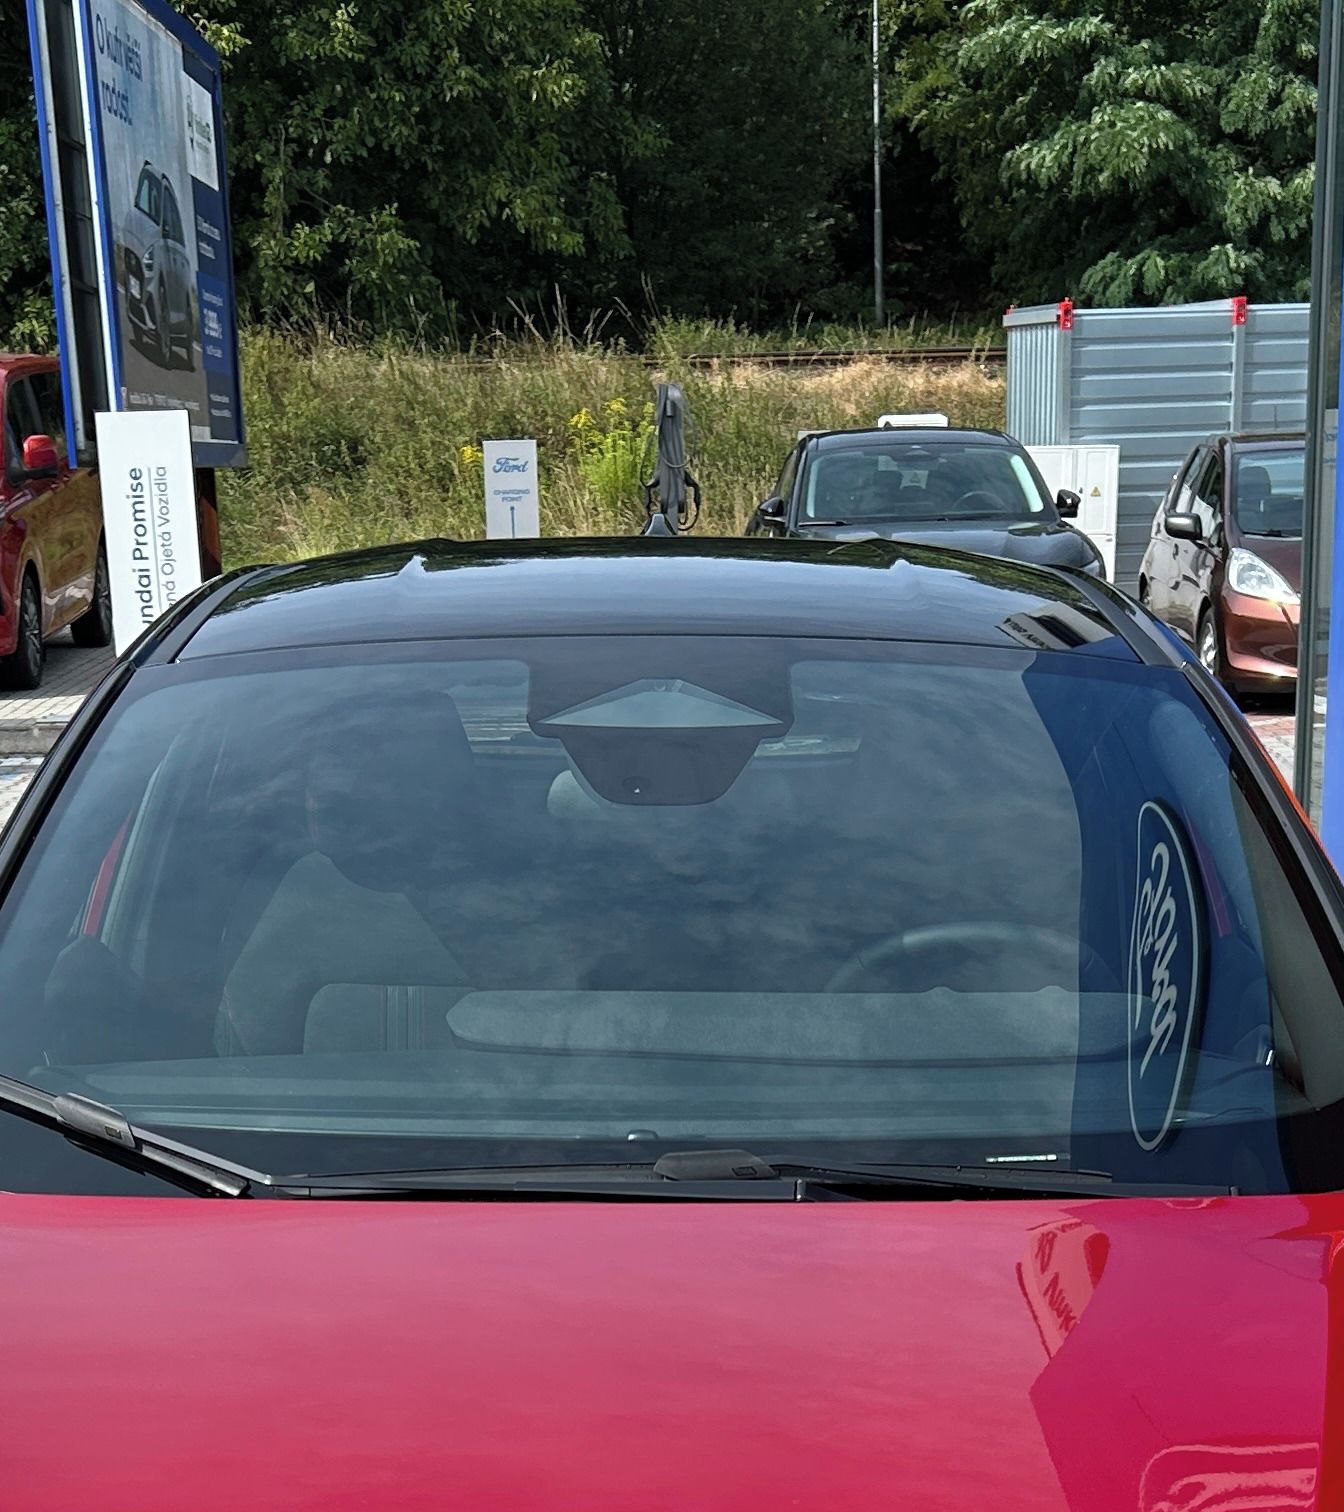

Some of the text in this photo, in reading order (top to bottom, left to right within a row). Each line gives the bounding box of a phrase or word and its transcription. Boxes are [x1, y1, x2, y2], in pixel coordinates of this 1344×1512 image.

[492, 456, 529, 474] Ford
[126, 467, 150, 561] Promise
[154, 466, 171, 528] Vozidla
[159, 531, 177, 576] Ojetá
